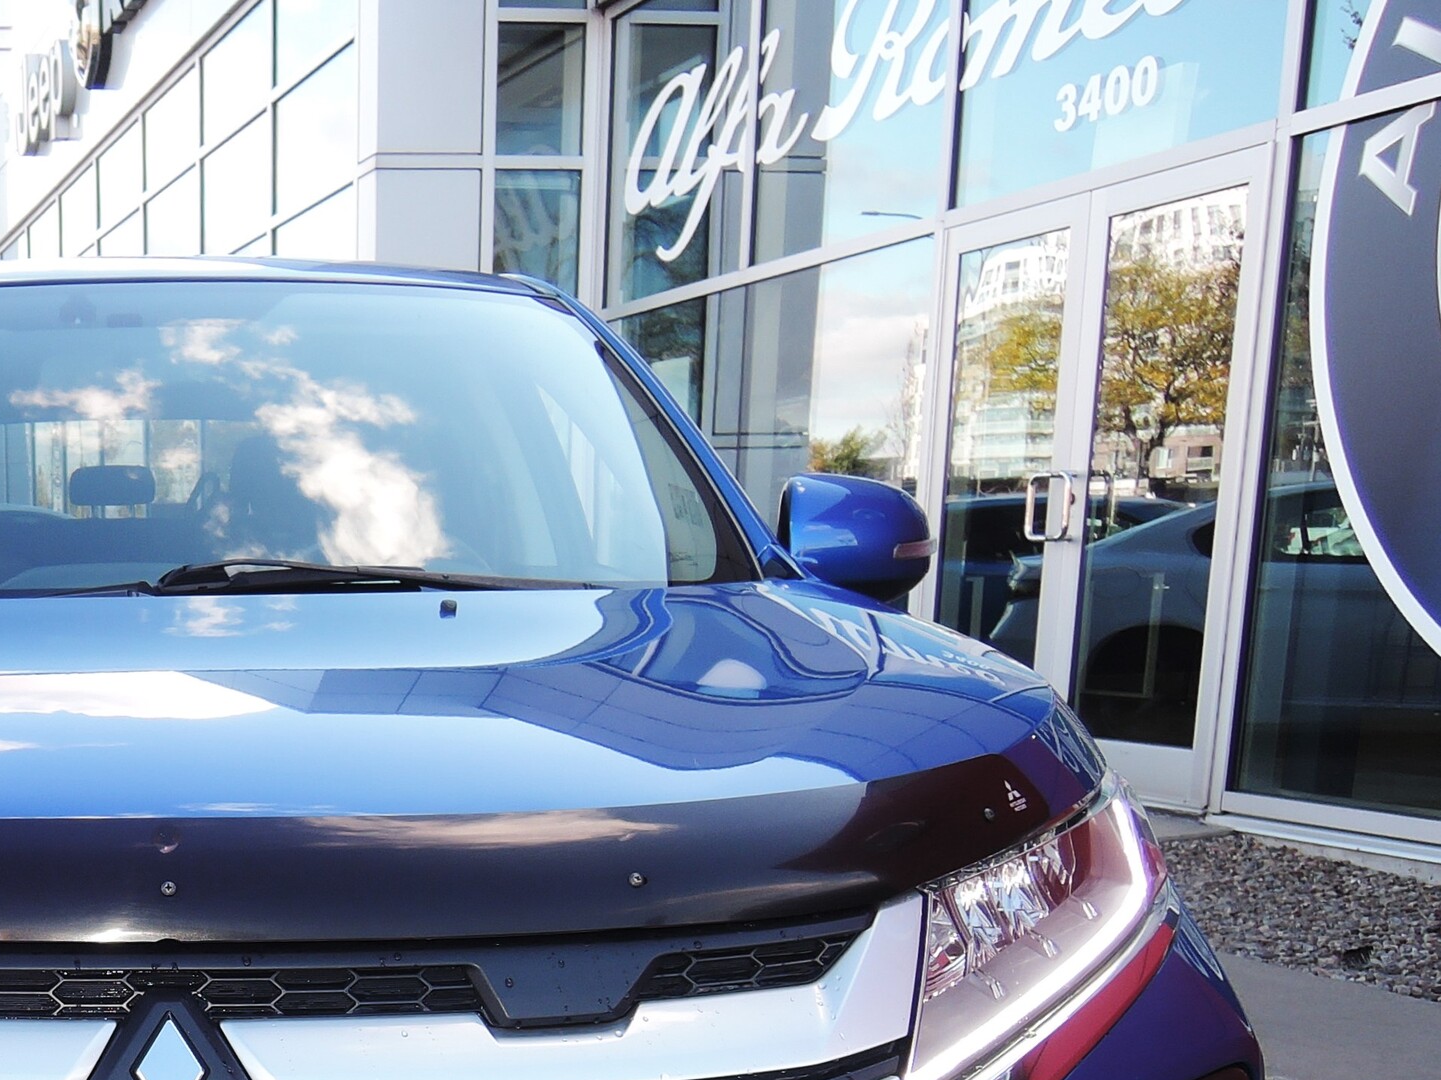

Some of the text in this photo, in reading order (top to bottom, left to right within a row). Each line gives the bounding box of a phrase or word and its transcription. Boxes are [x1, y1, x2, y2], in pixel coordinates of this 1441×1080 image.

[16, 40, 74, 156] Jeep
[625, 0, 1188, 262] Alfa Rom
[1053, 55, 1158, 132] 3400
